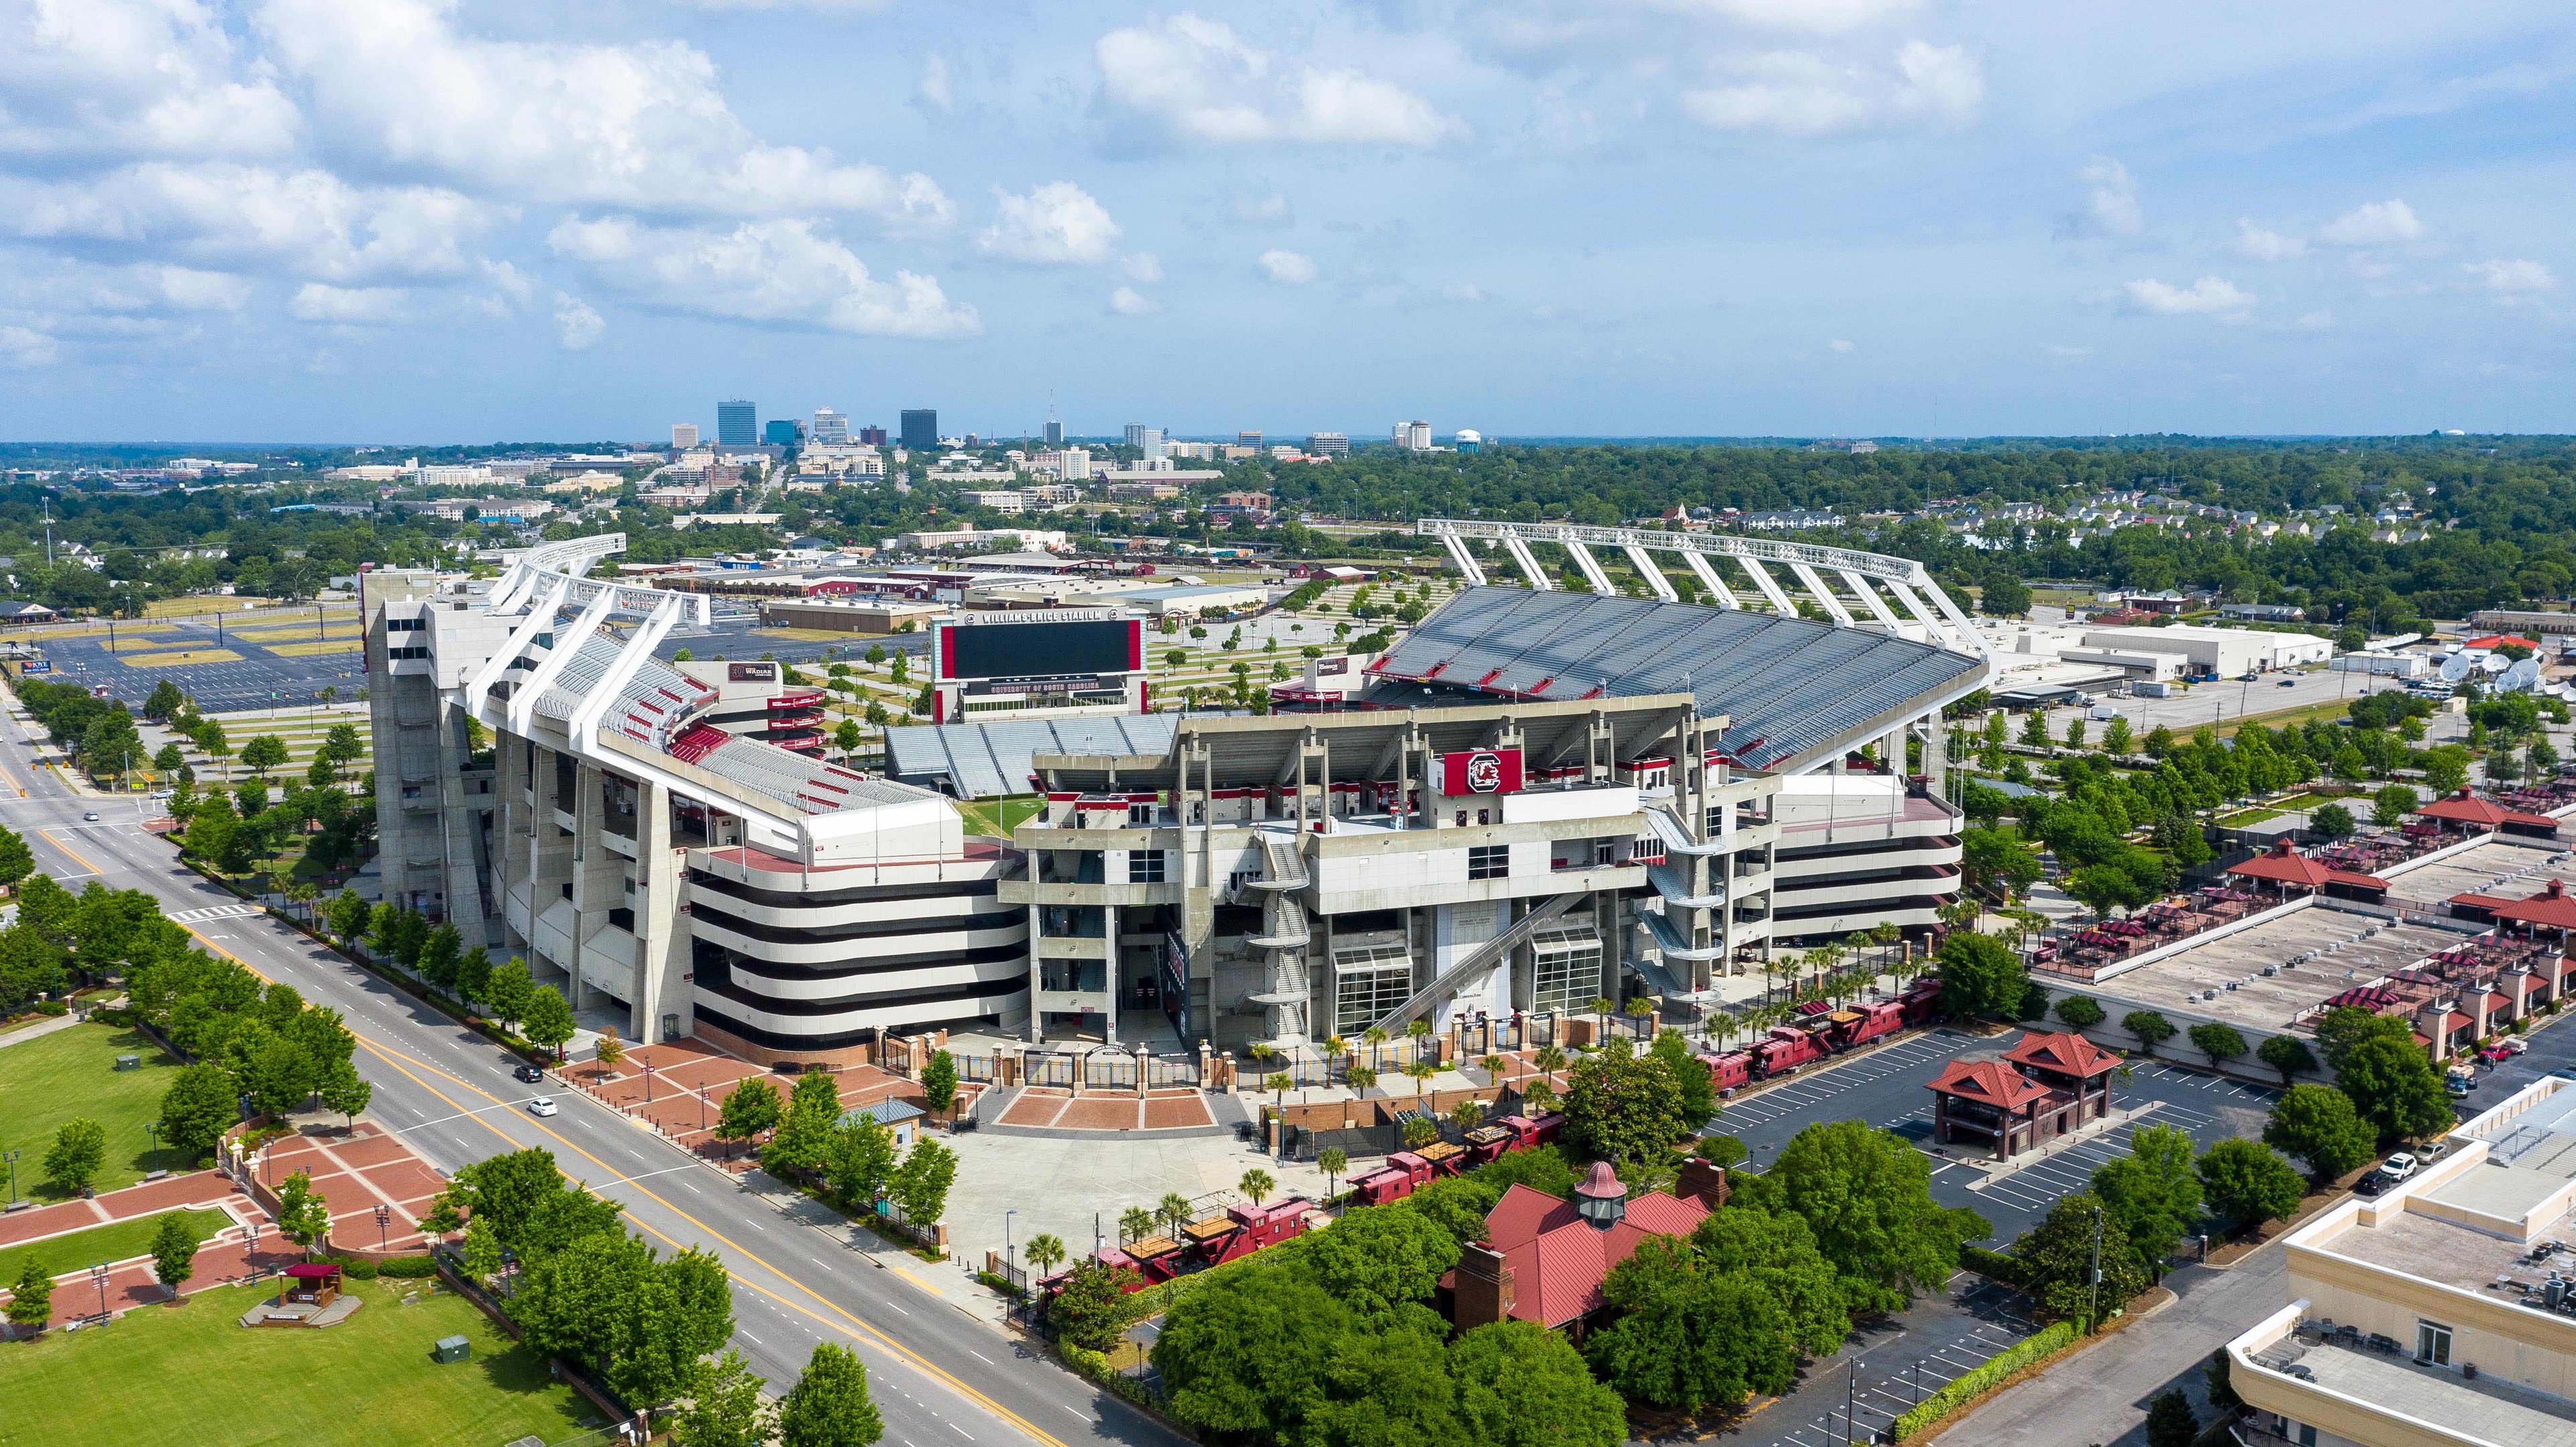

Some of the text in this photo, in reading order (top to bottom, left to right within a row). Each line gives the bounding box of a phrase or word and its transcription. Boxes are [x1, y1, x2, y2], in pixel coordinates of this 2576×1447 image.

[983, 610, 1101, 623] WILLIAMS-BRICE STADIUM
[732, 666, 744, 678] 37
[991, 685, 1031, 693] UNIVERSITY
